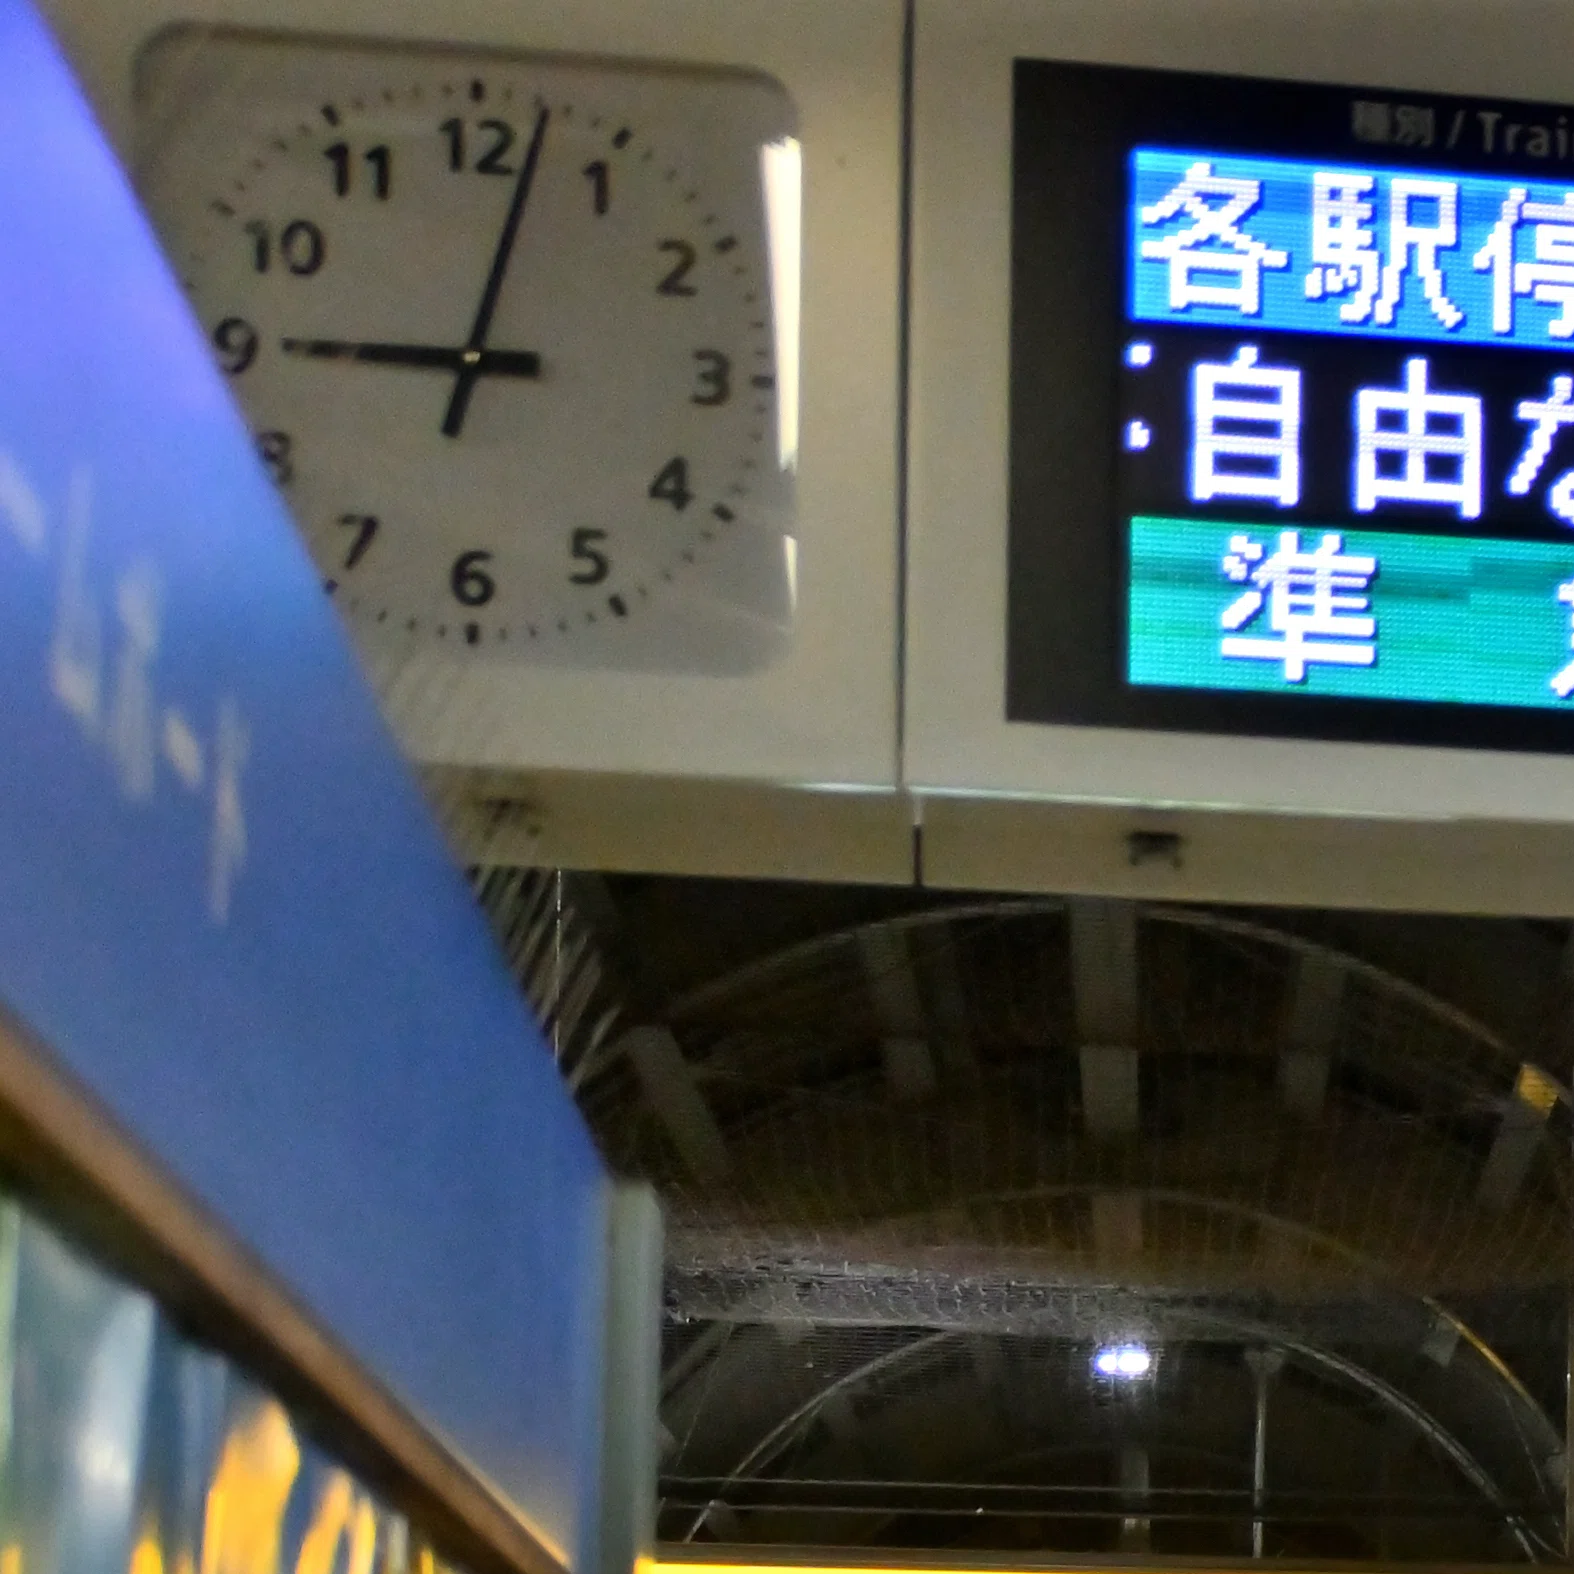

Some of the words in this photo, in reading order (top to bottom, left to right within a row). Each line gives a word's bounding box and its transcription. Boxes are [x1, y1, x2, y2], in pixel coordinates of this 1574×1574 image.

[322, 144, 392, 201] 11
[437, 118, 518, 177] 12
[582, 160, 612, 215] 1
[244, 218, 327, 277] 10
[655, 239, 698, 296] 2
[211, 316, 259, 374] 9
[692, 349, 733, 406] 3
[648, 457, 694, 511] 4
[335, 513, 381, 571] 7
[568, 528, 610, 584] 5
[450, 550, 496, 606] 6
